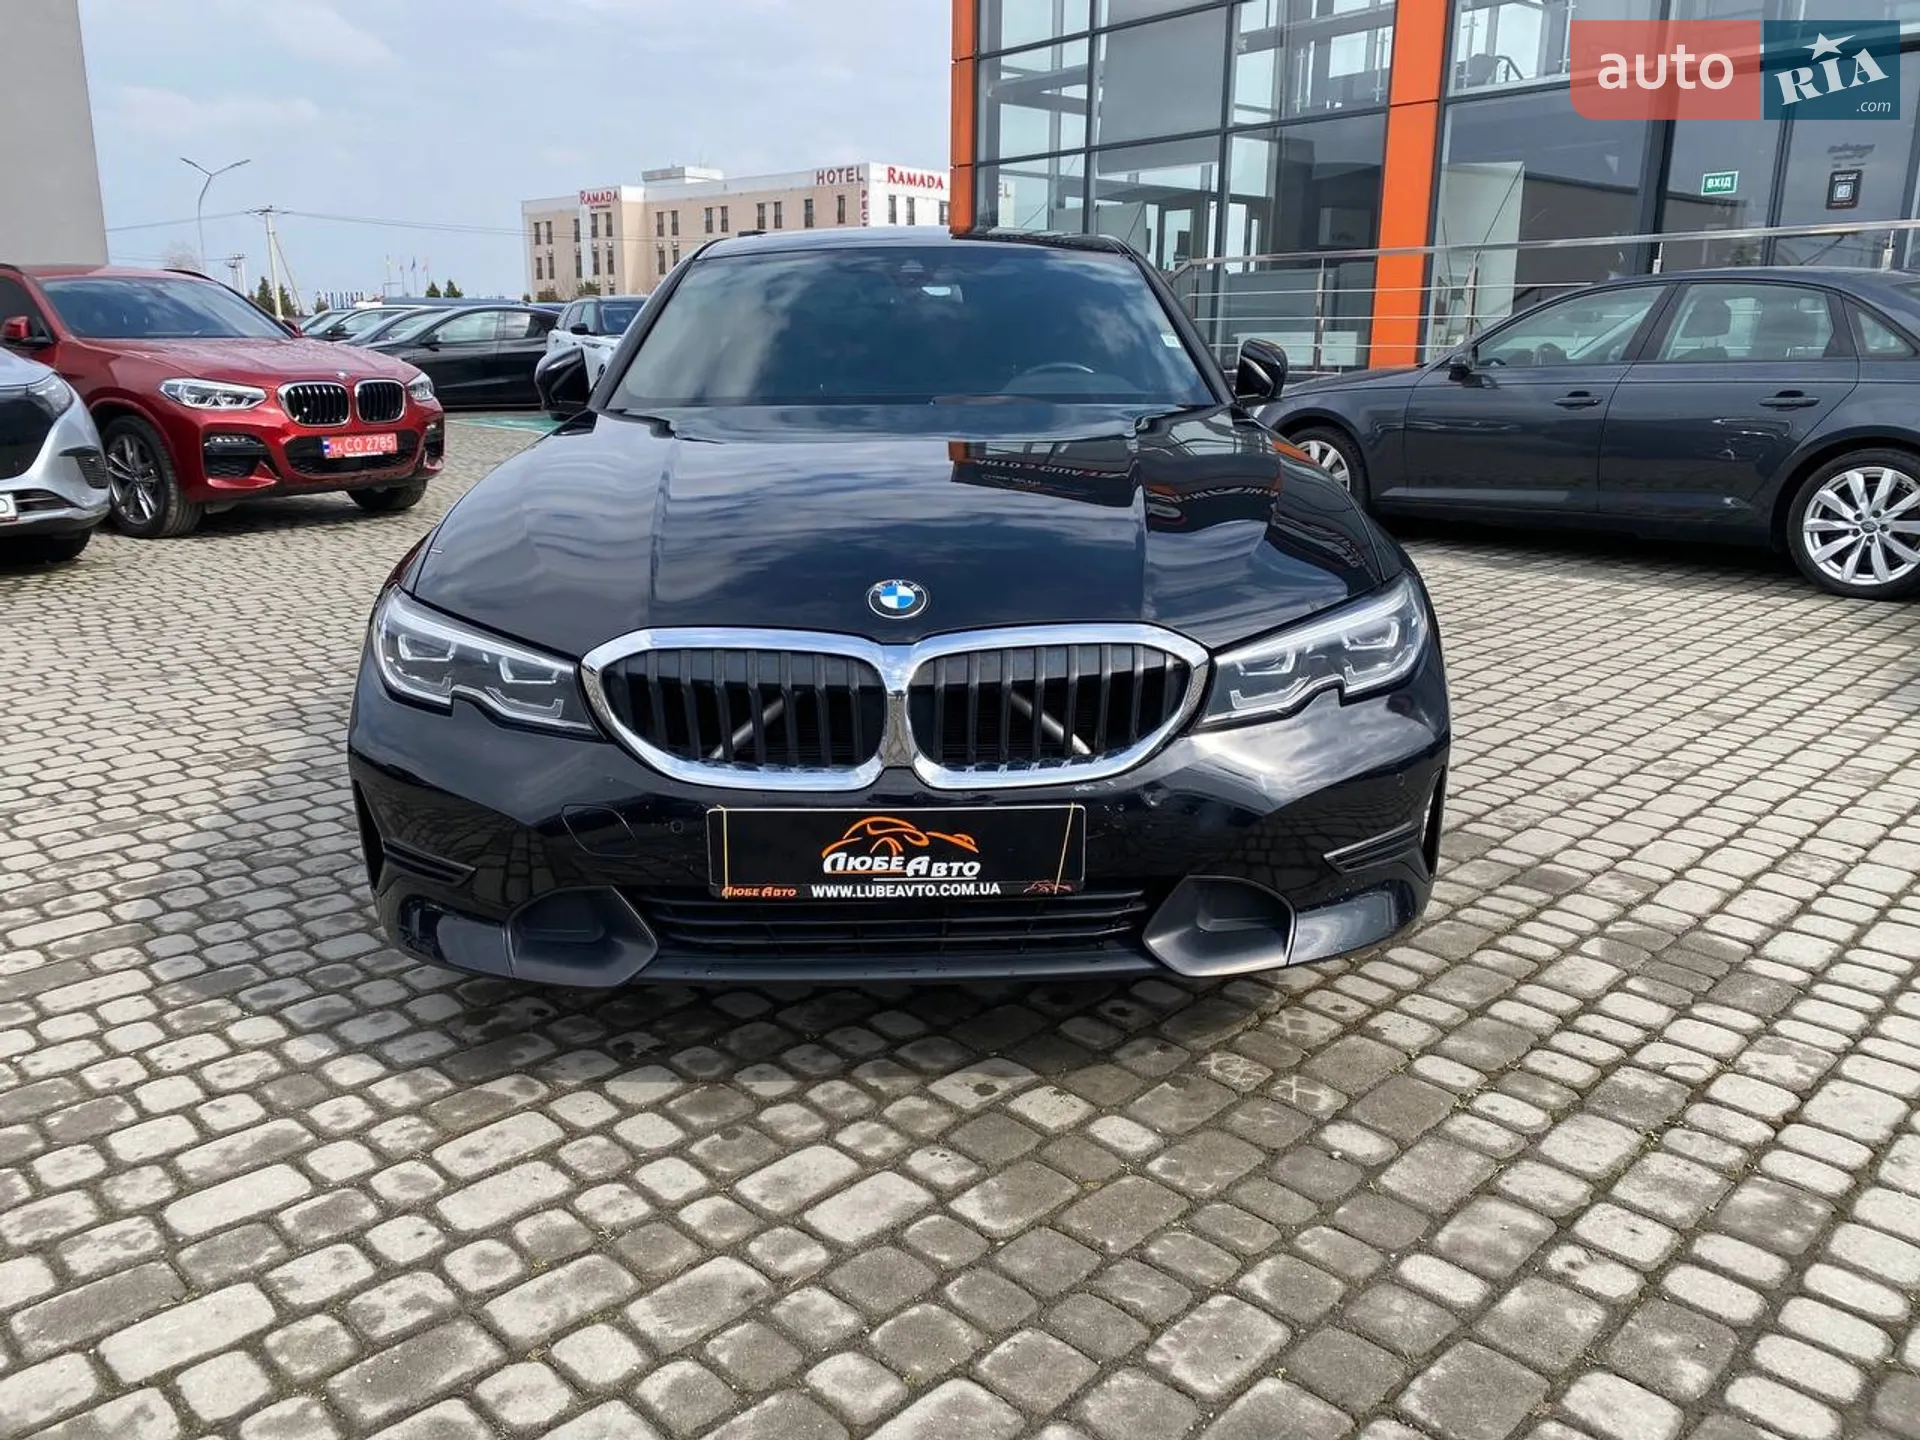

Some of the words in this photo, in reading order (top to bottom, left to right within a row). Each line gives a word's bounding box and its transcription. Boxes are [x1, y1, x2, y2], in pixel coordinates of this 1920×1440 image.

[816, 166, 865, 185] HOTEL
[887, 166, 944, 190] RAMADA
[579, 190, 620, 205] RAMADA
[811, 882, 1001, 898] WWW.LUBEAVTO.COM.UA
